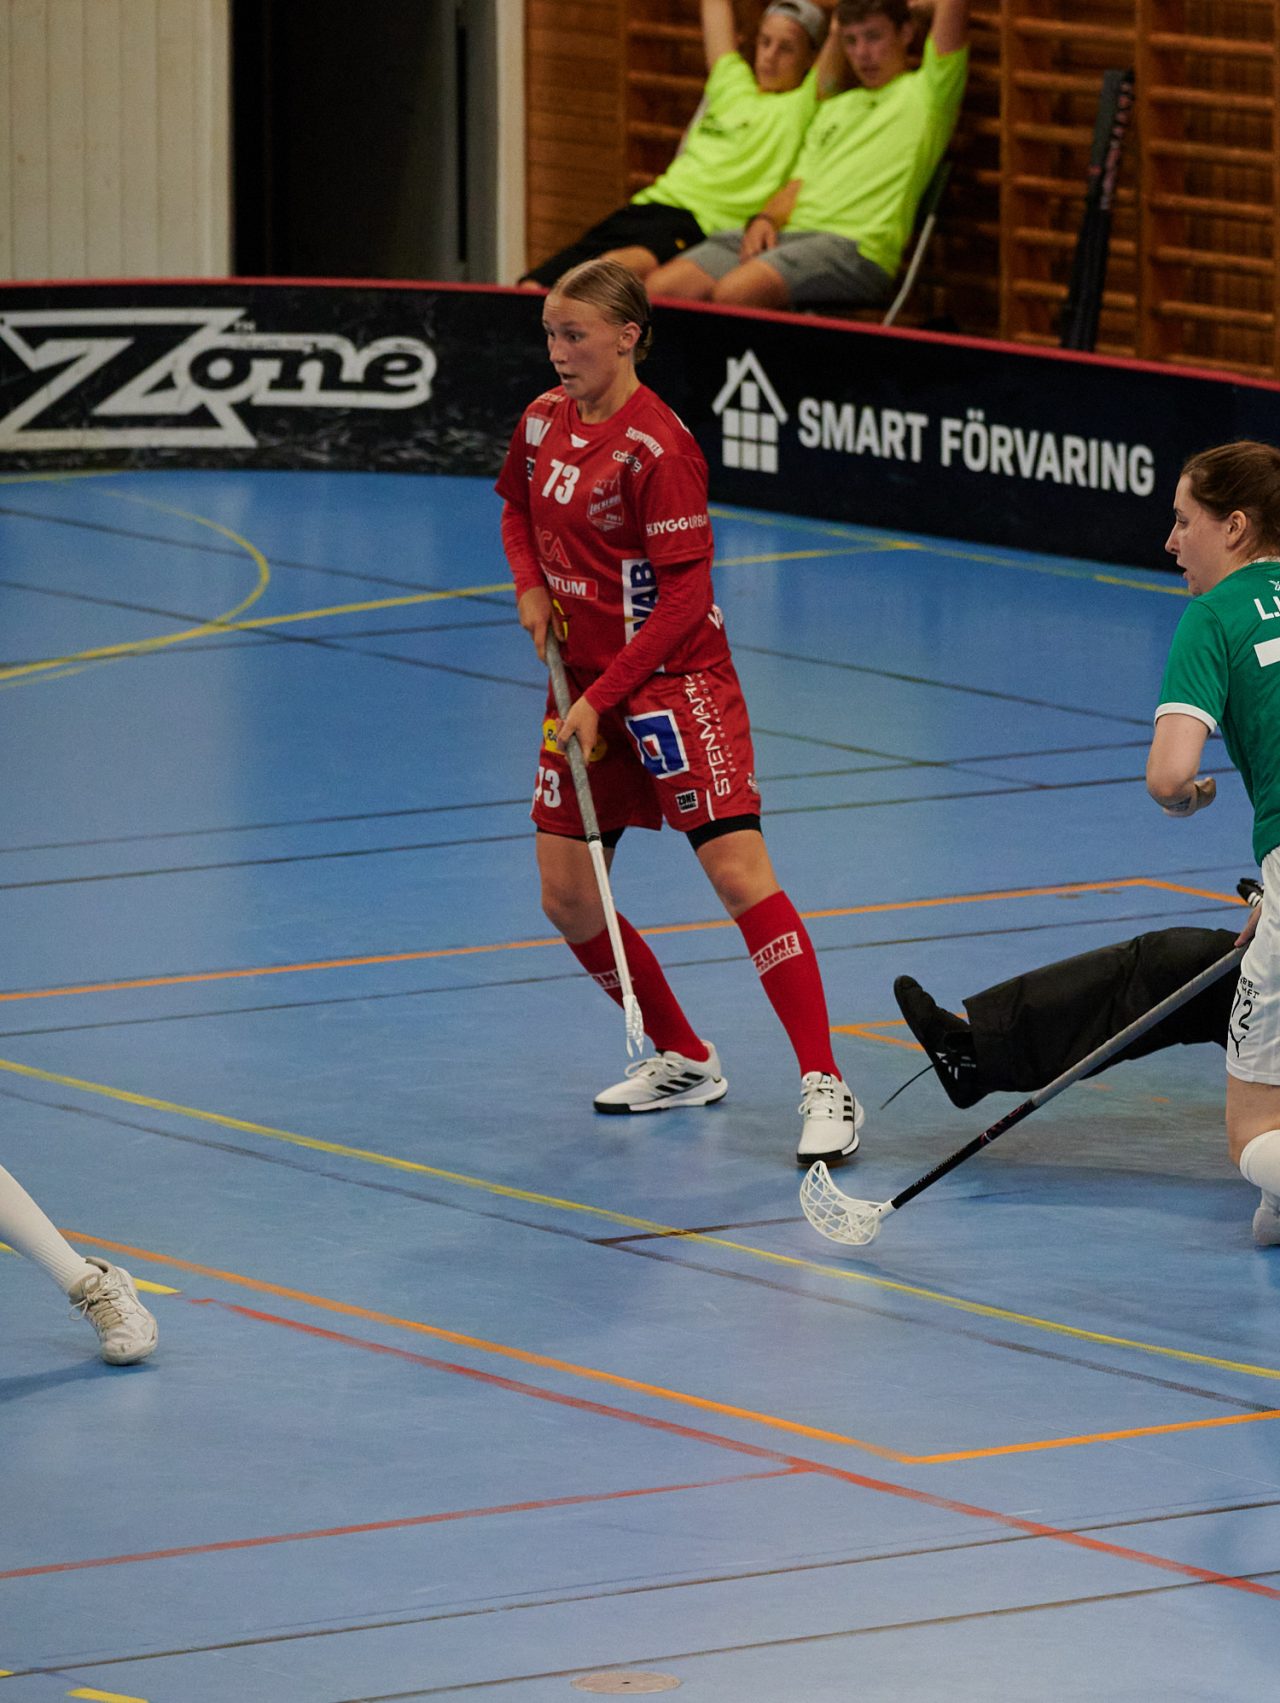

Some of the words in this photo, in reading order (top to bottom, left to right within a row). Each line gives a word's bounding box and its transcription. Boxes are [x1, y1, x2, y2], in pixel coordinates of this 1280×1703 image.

[0, 308, 437, 448] Zone
[541, 458, 581, 505] 73
[798, 398, 928, 463] SMART
[940, 409, 1155, 496] FÖRVARING
[753, 935, 796, 968] ZONE
